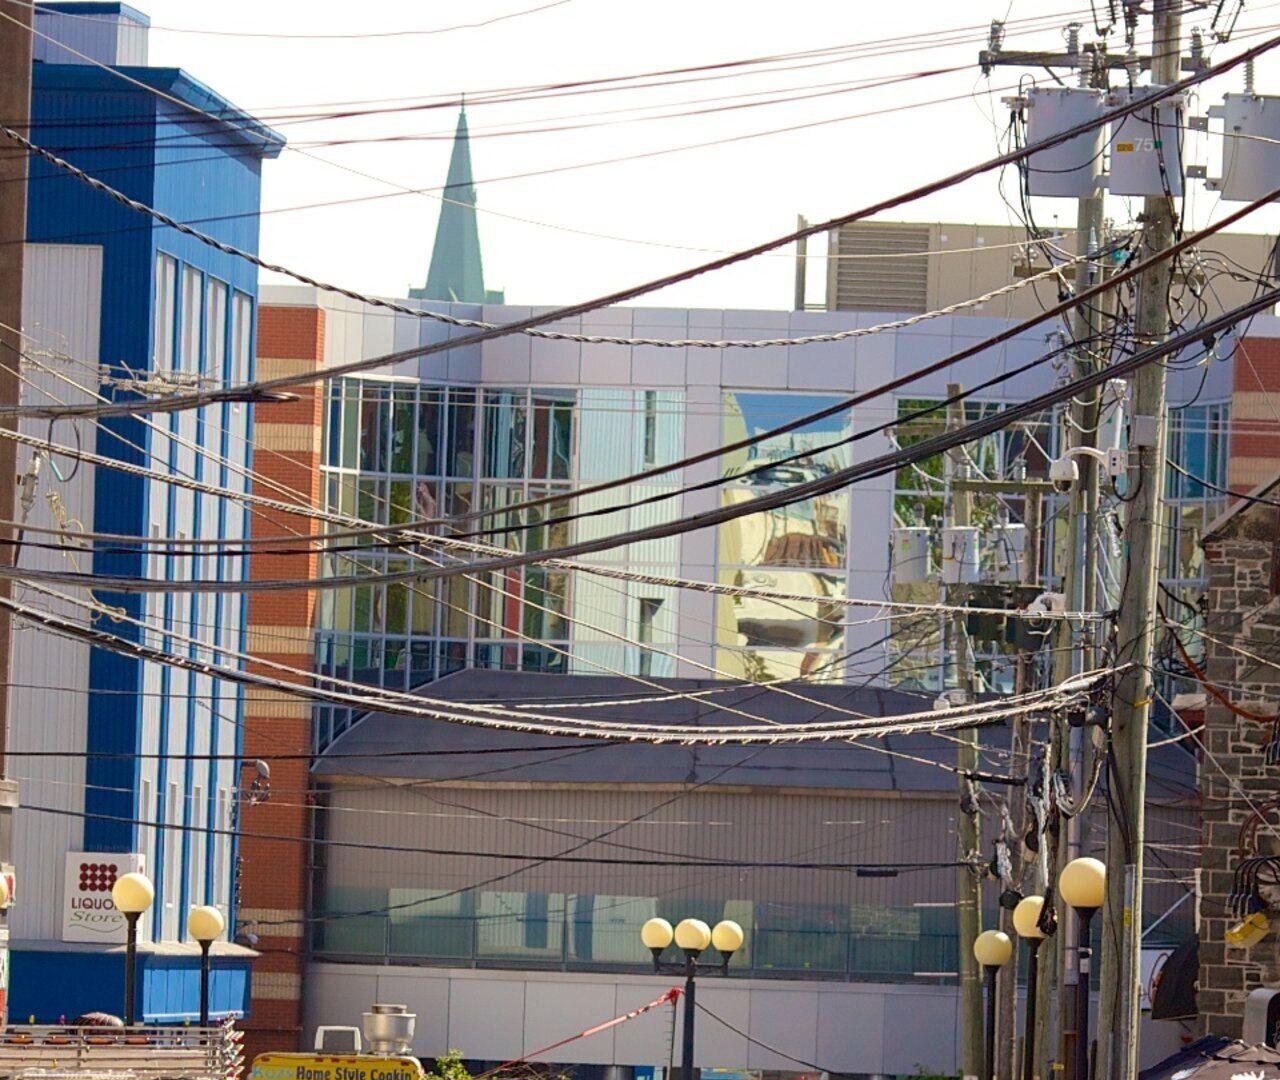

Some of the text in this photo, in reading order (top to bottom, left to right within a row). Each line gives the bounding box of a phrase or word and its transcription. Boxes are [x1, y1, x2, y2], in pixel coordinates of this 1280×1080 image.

[71, 897, 118, 911] LIQUO
[70, 910, 122, 923] Store
[296, 1066, 331, 1080] Home
